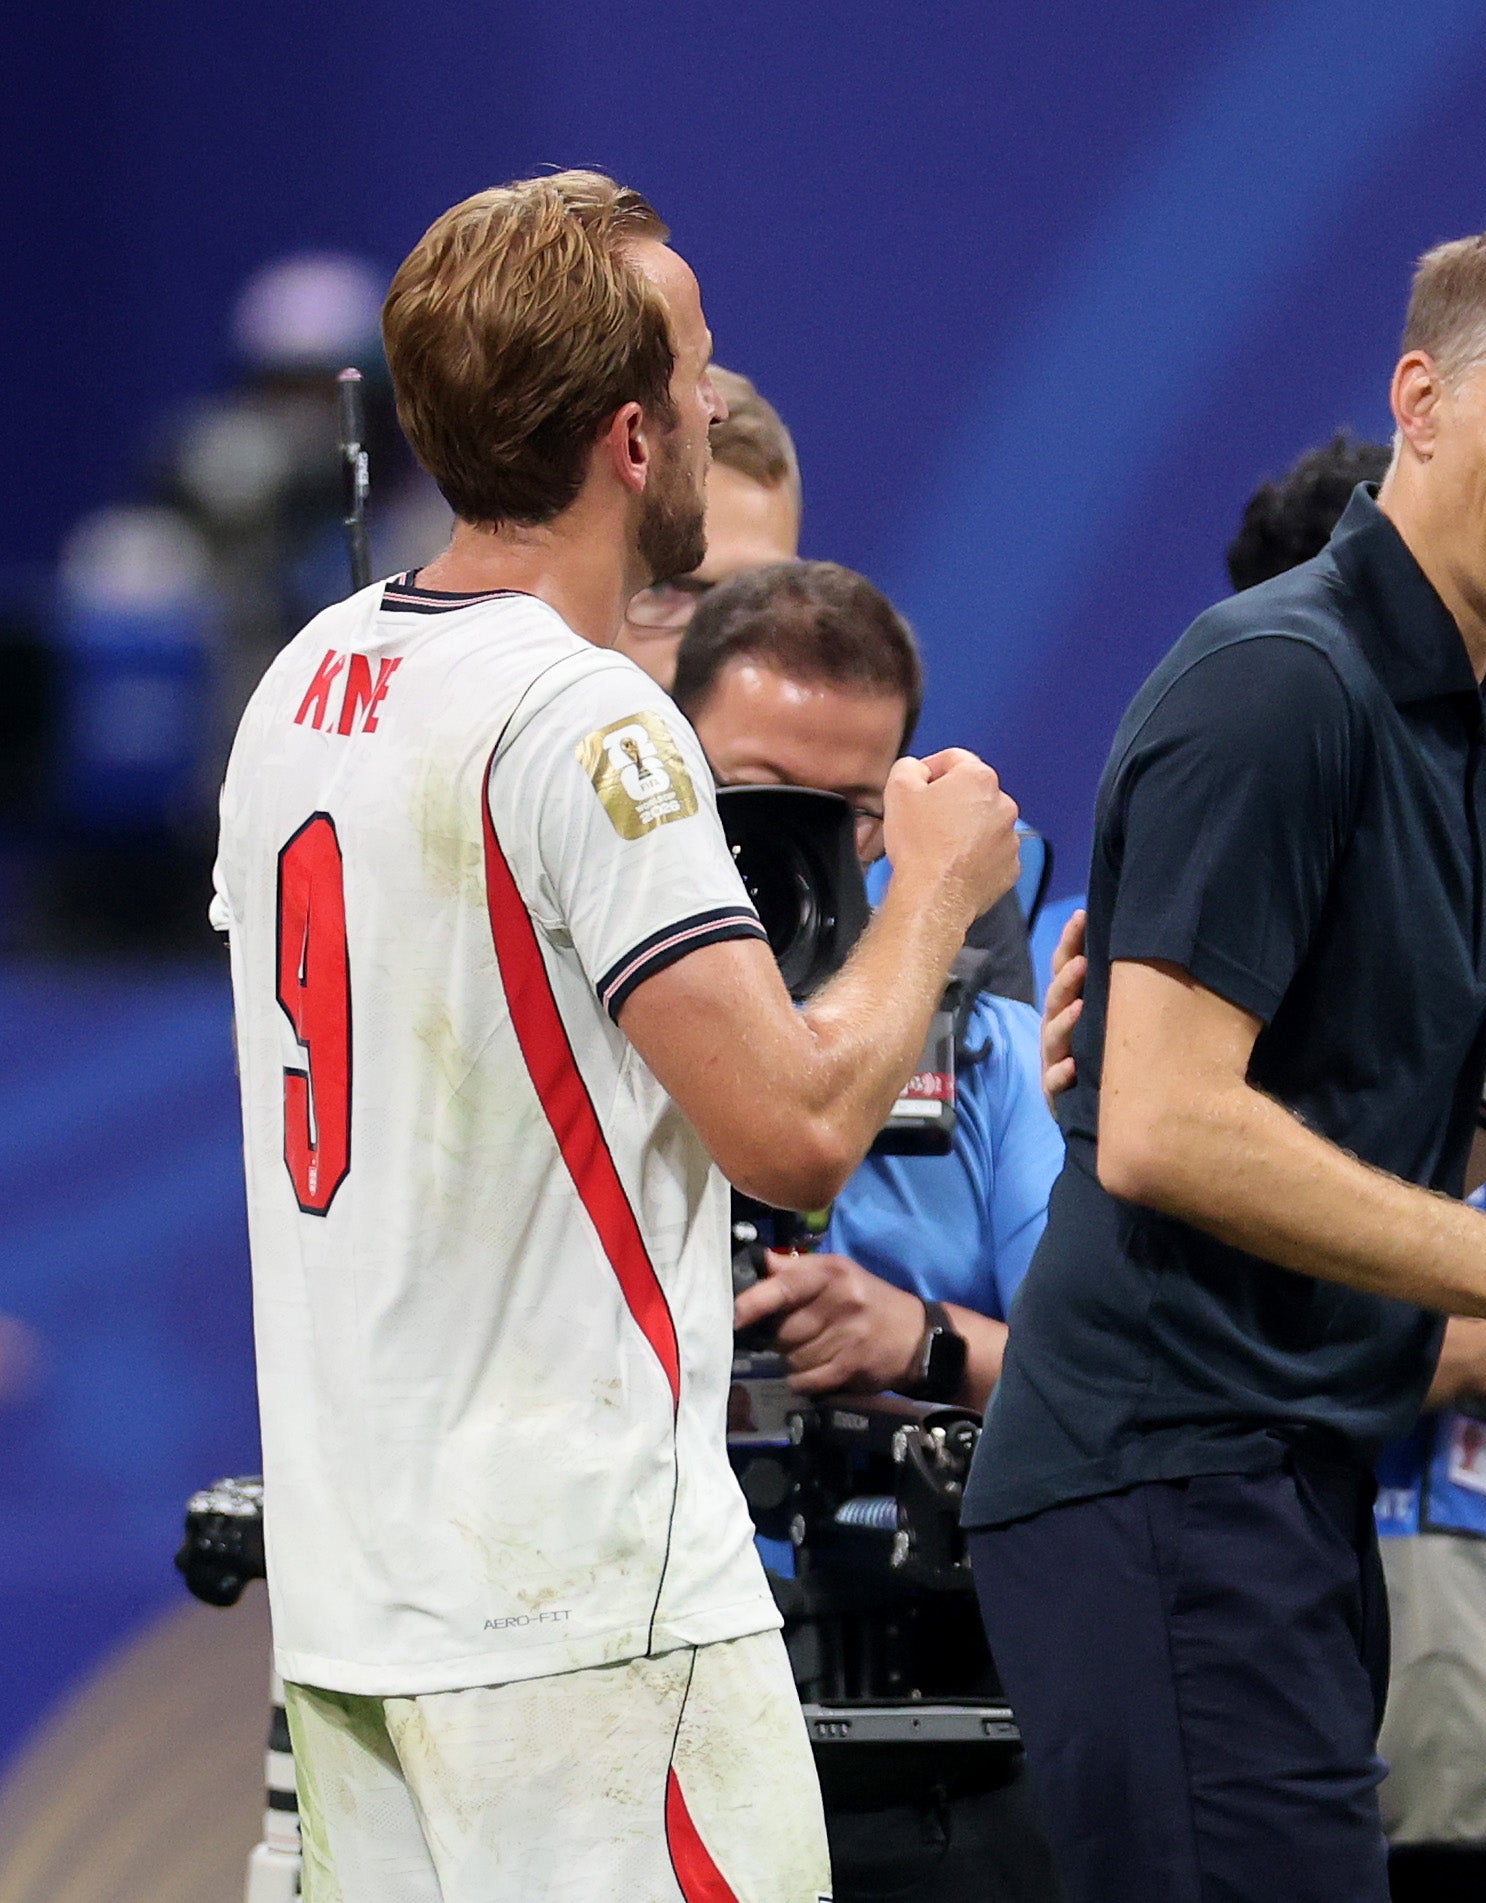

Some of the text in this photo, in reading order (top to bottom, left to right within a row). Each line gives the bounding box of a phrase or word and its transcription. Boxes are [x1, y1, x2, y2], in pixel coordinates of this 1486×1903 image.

[293, 649, 404, 736] KNE
[276, 811, 352, 1217] 9
[483, 1609, 572, 1630] AERO-FIT
